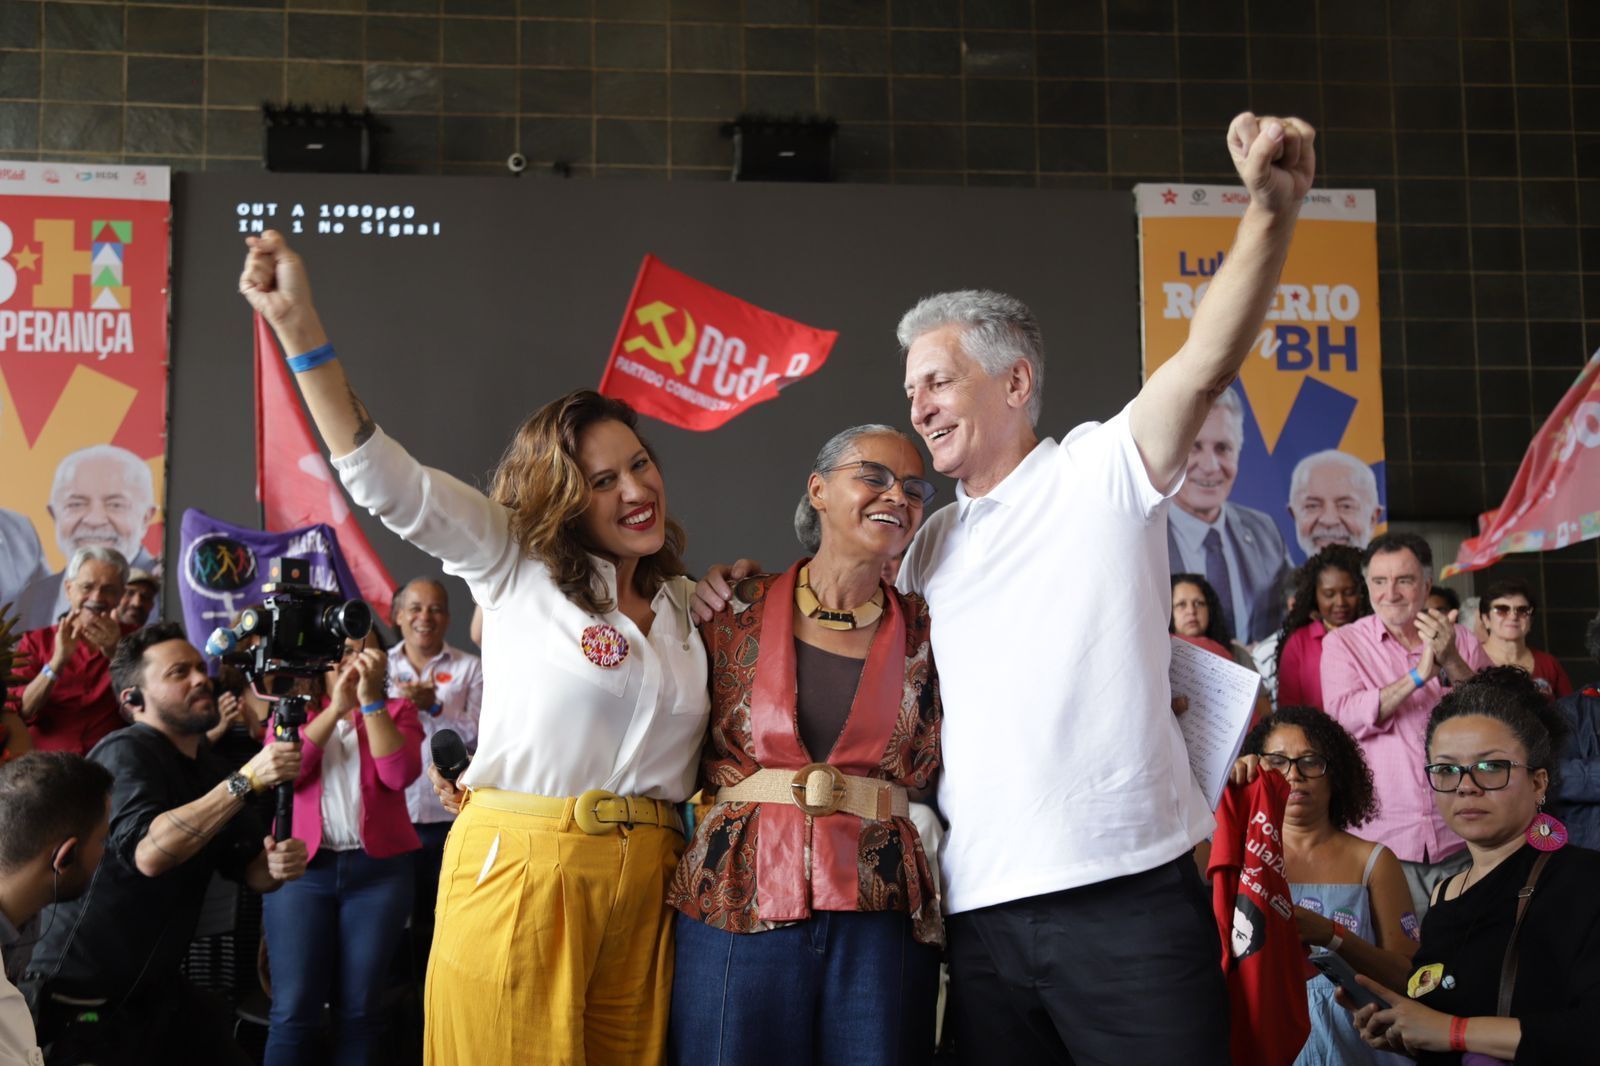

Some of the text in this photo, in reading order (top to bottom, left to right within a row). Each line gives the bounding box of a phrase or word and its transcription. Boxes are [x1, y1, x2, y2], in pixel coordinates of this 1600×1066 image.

[236, 203, 416, 221] OUT A 1080p60
[238, 219, 441, 238] IN 1 No Signal
[1179, 251, 1224, 277] Lul
[1275, 324, 1358, 373] BH
[614, 355, 665, 388] PARTIDO
[1251, 811, 1282, 847] Pos
[1333, 915, 1359, 929] ZERO
